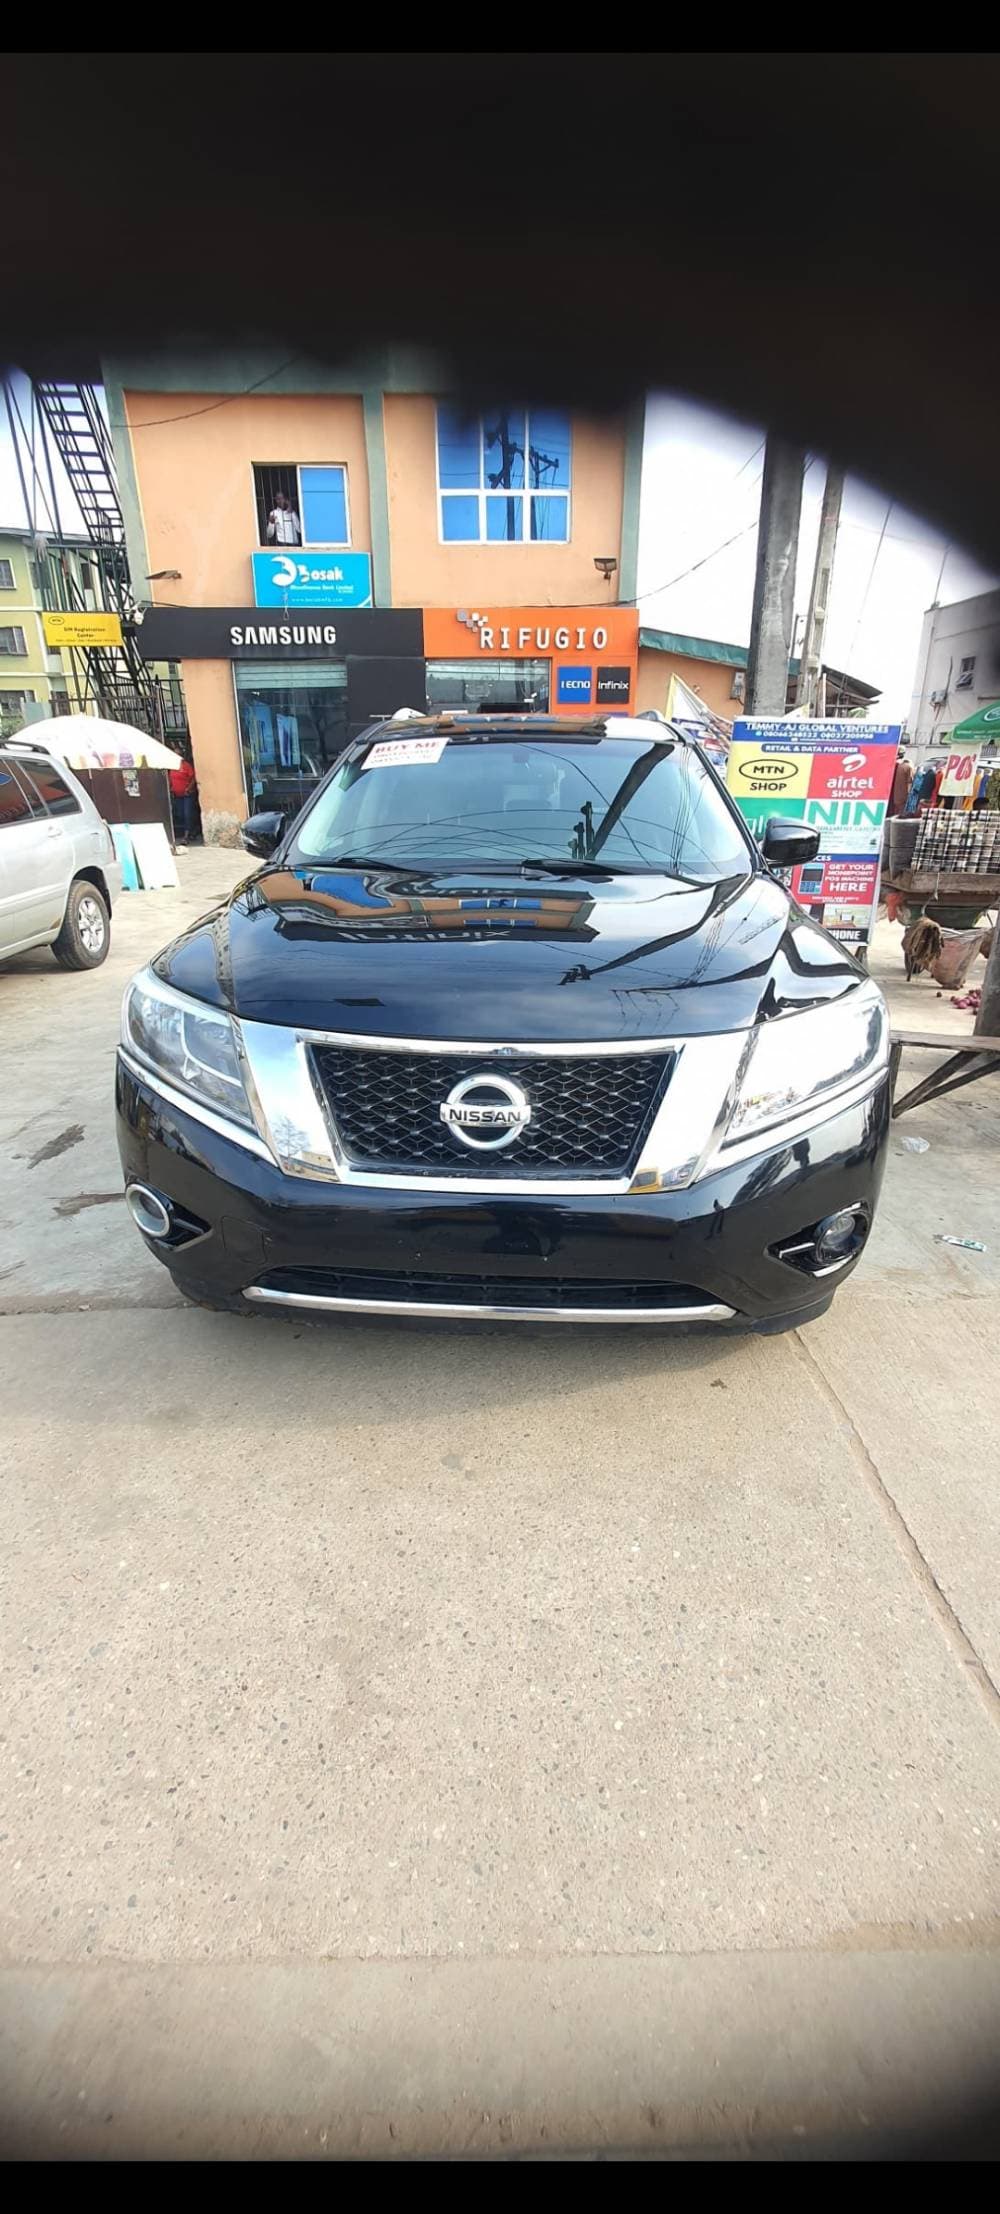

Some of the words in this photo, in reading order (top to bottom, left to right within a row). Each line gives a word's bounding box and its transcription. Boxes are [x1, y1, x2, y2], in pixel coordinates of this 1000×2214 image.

[230, 626, 337, 646] SAMSUNG
[480, 627, 608, 650] RIFUGIO
[562, 681, 591, 690] TECNO
[797, 723, 838, 734] GLOBAL
[839, 724, 889, 736] VENTURES
[800, 745, 823, 753] DATA
[753, 766, 785, 774] MTN
[750, 782, 788, 791] SHOP
[826, 776, 875, 789] airtel
[831, 790, 863, 799] SHOP
[807, 801, 885, 826] NIN
[829, 863, 847, 871] GET
[848, 864, 874, 872] YOUR
[829, 882, 868, 893] HERE
[449, 1108, 521, 1122] NISSAN
